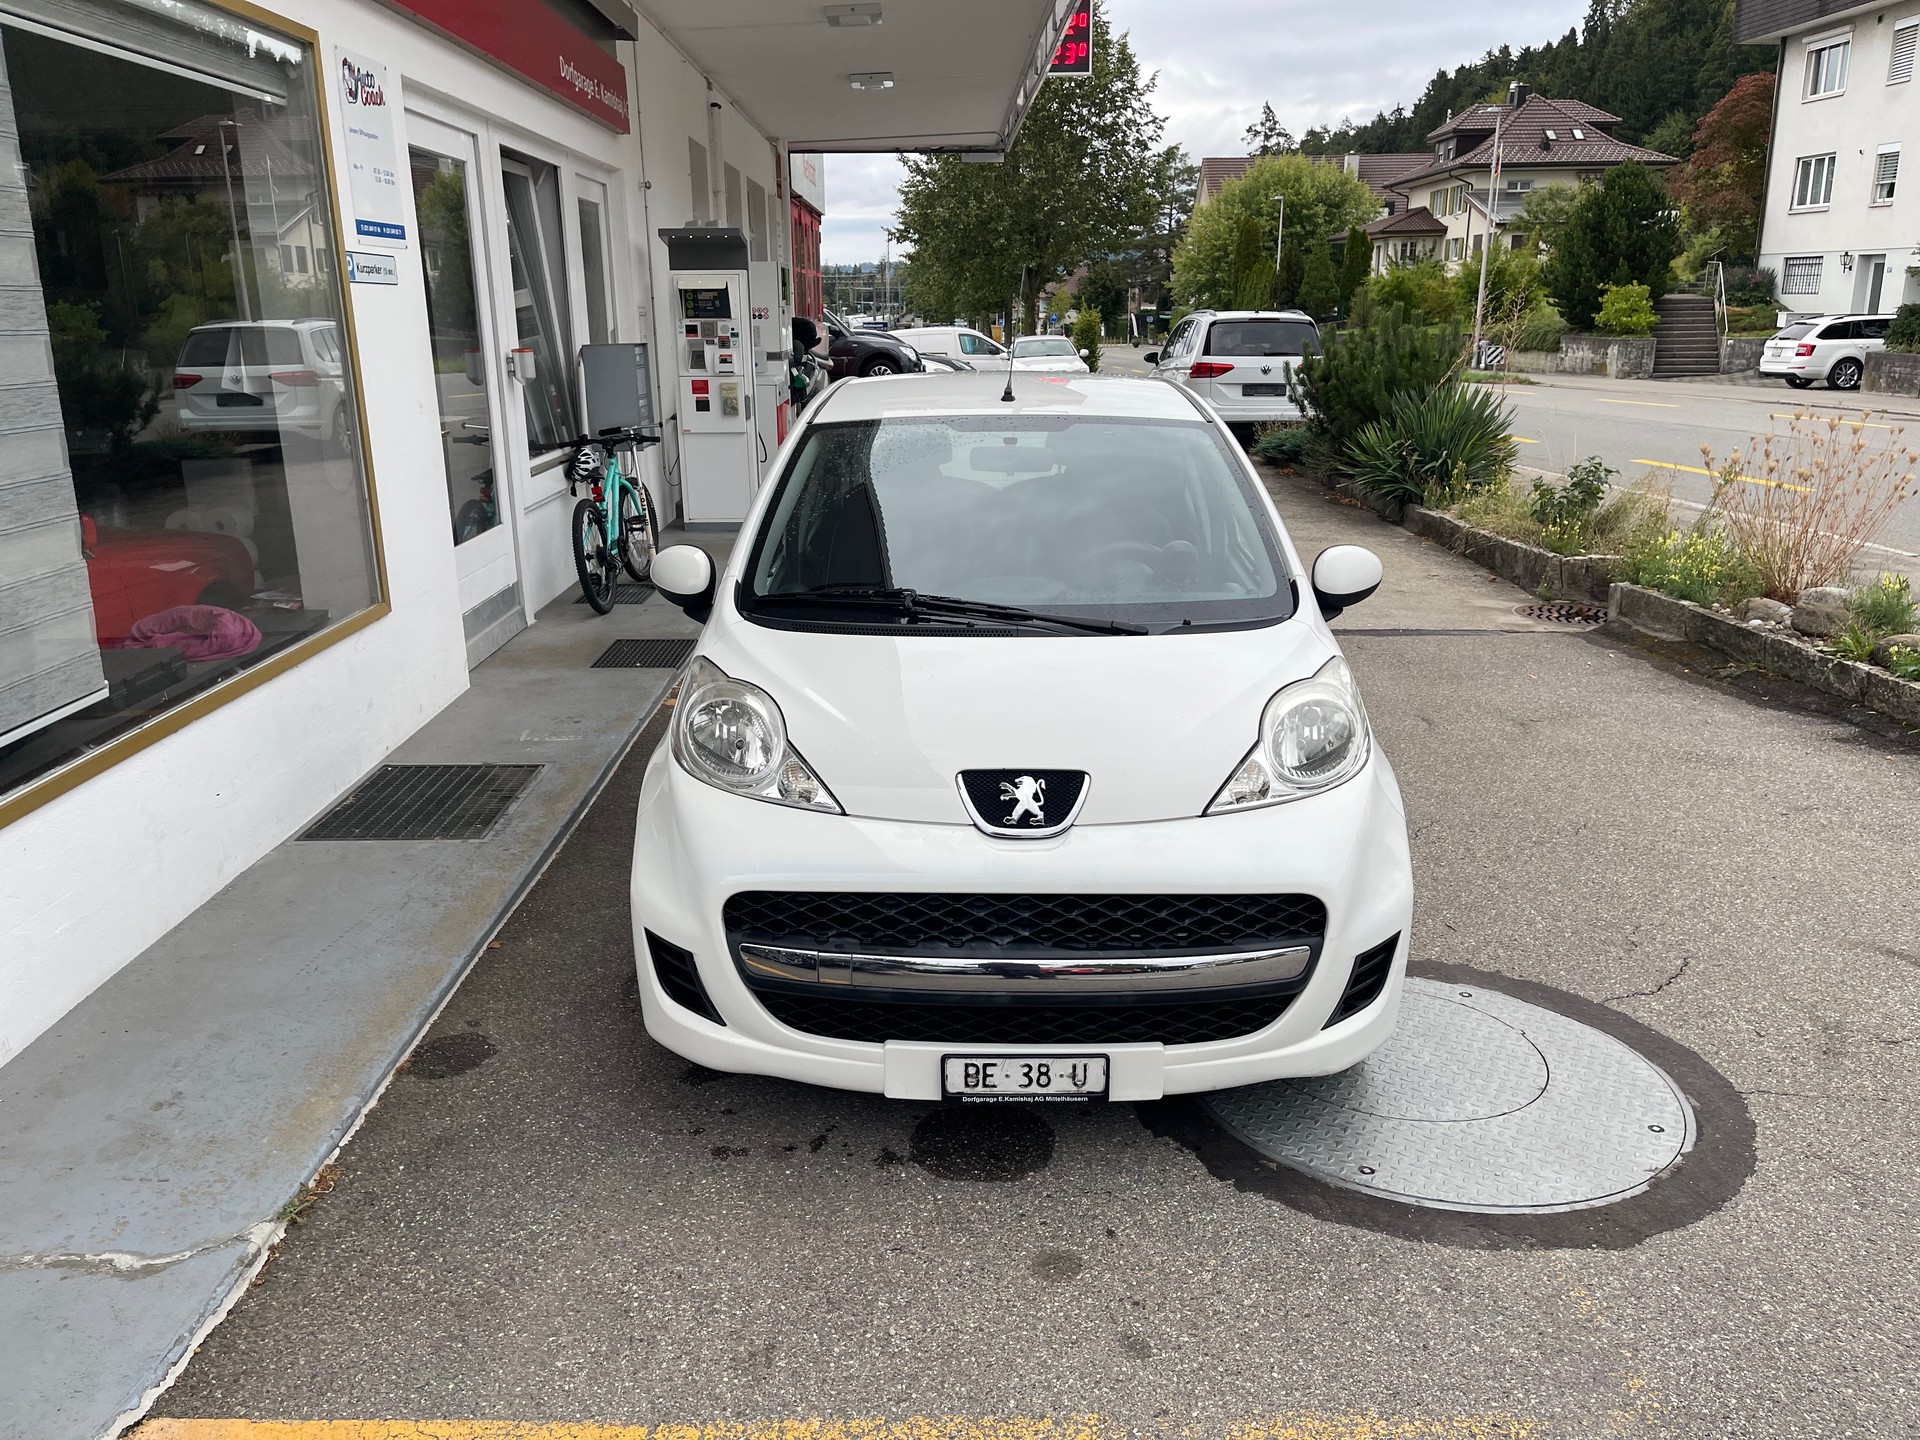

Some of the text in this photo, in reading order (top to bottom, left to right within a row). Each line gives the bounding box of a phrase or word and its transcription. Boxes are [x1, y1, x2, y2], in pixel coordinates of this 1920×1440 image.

[559, 55, 595, 99] Dorfgarage
[593, 78, 601, 100] E.
[356, 262, 382, 276] Kurzparker
[964, 1062, 1088, 1088] BE 38 U
